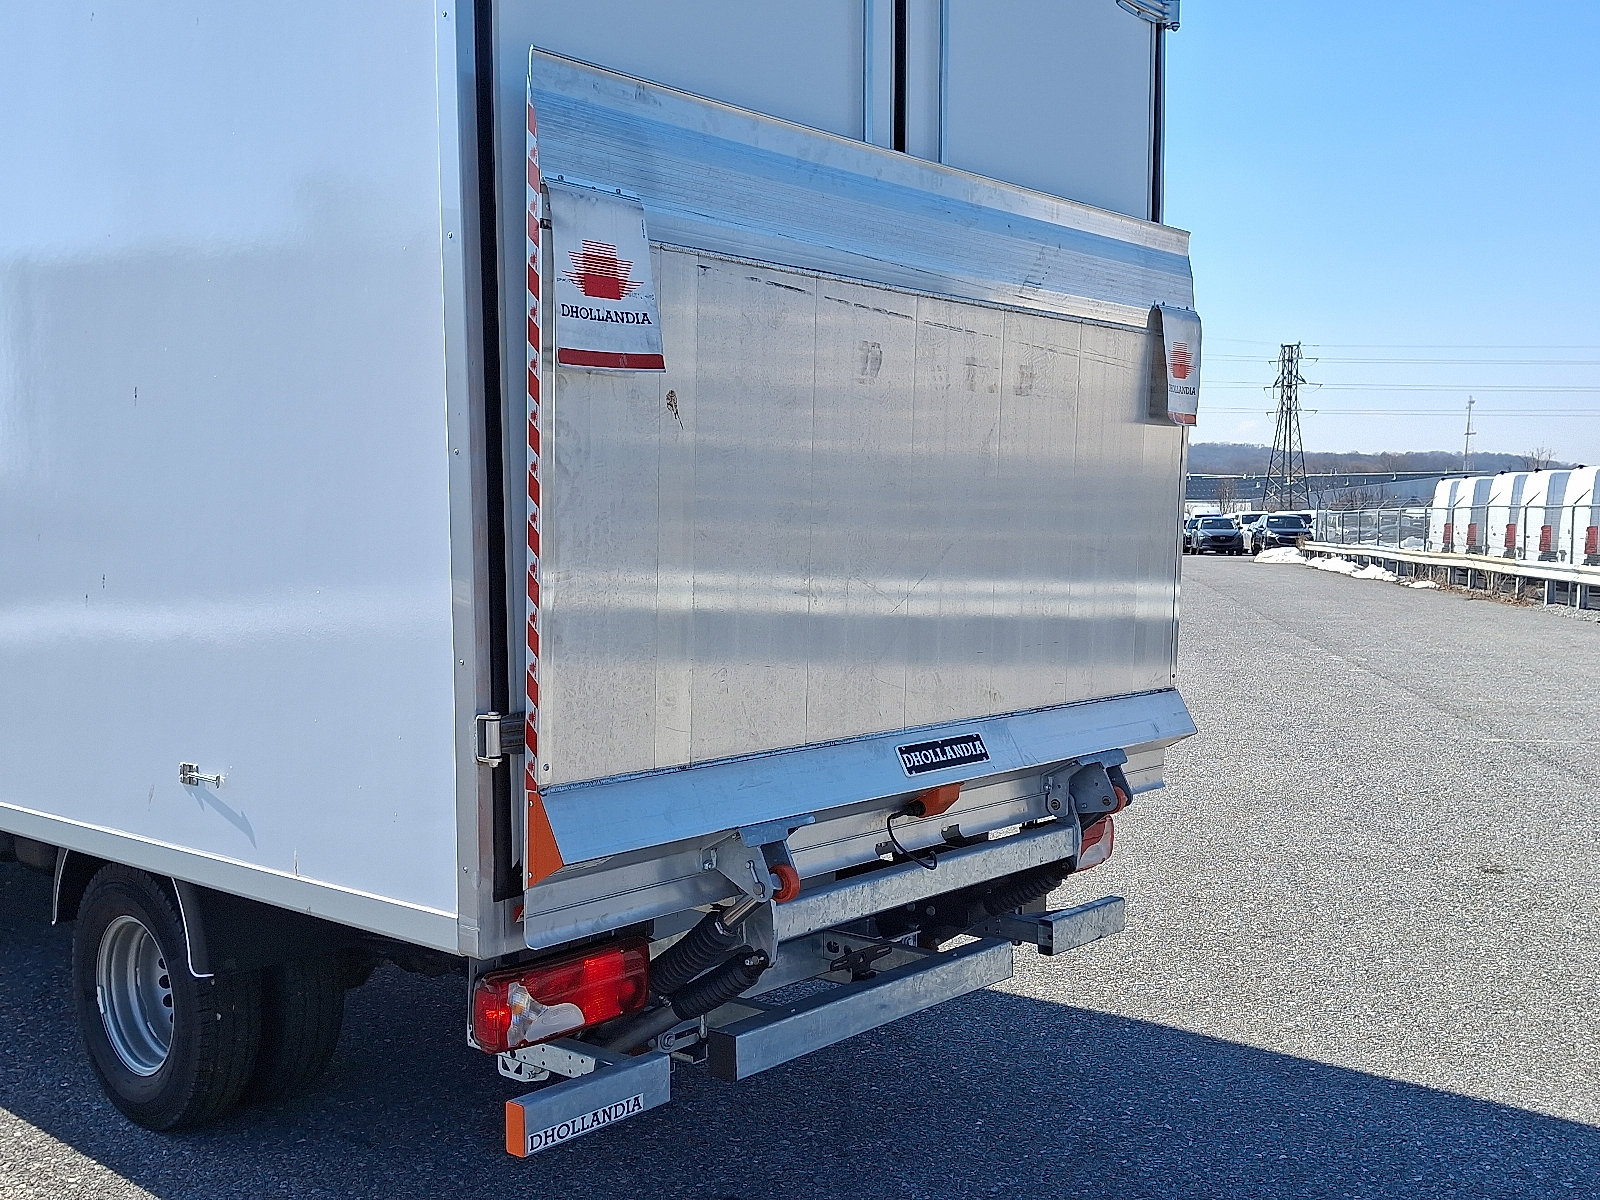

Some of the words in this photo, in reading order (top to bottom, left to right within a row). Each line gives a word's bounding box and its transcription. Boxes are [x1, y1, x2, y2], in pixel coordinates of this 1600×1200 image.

[560, 303, 652, 325] DHOLLANDIA
[901, 740, 986, 768] DHOLLANDIA
[529, 1095, 643, 1152] DHOLLANDIA
